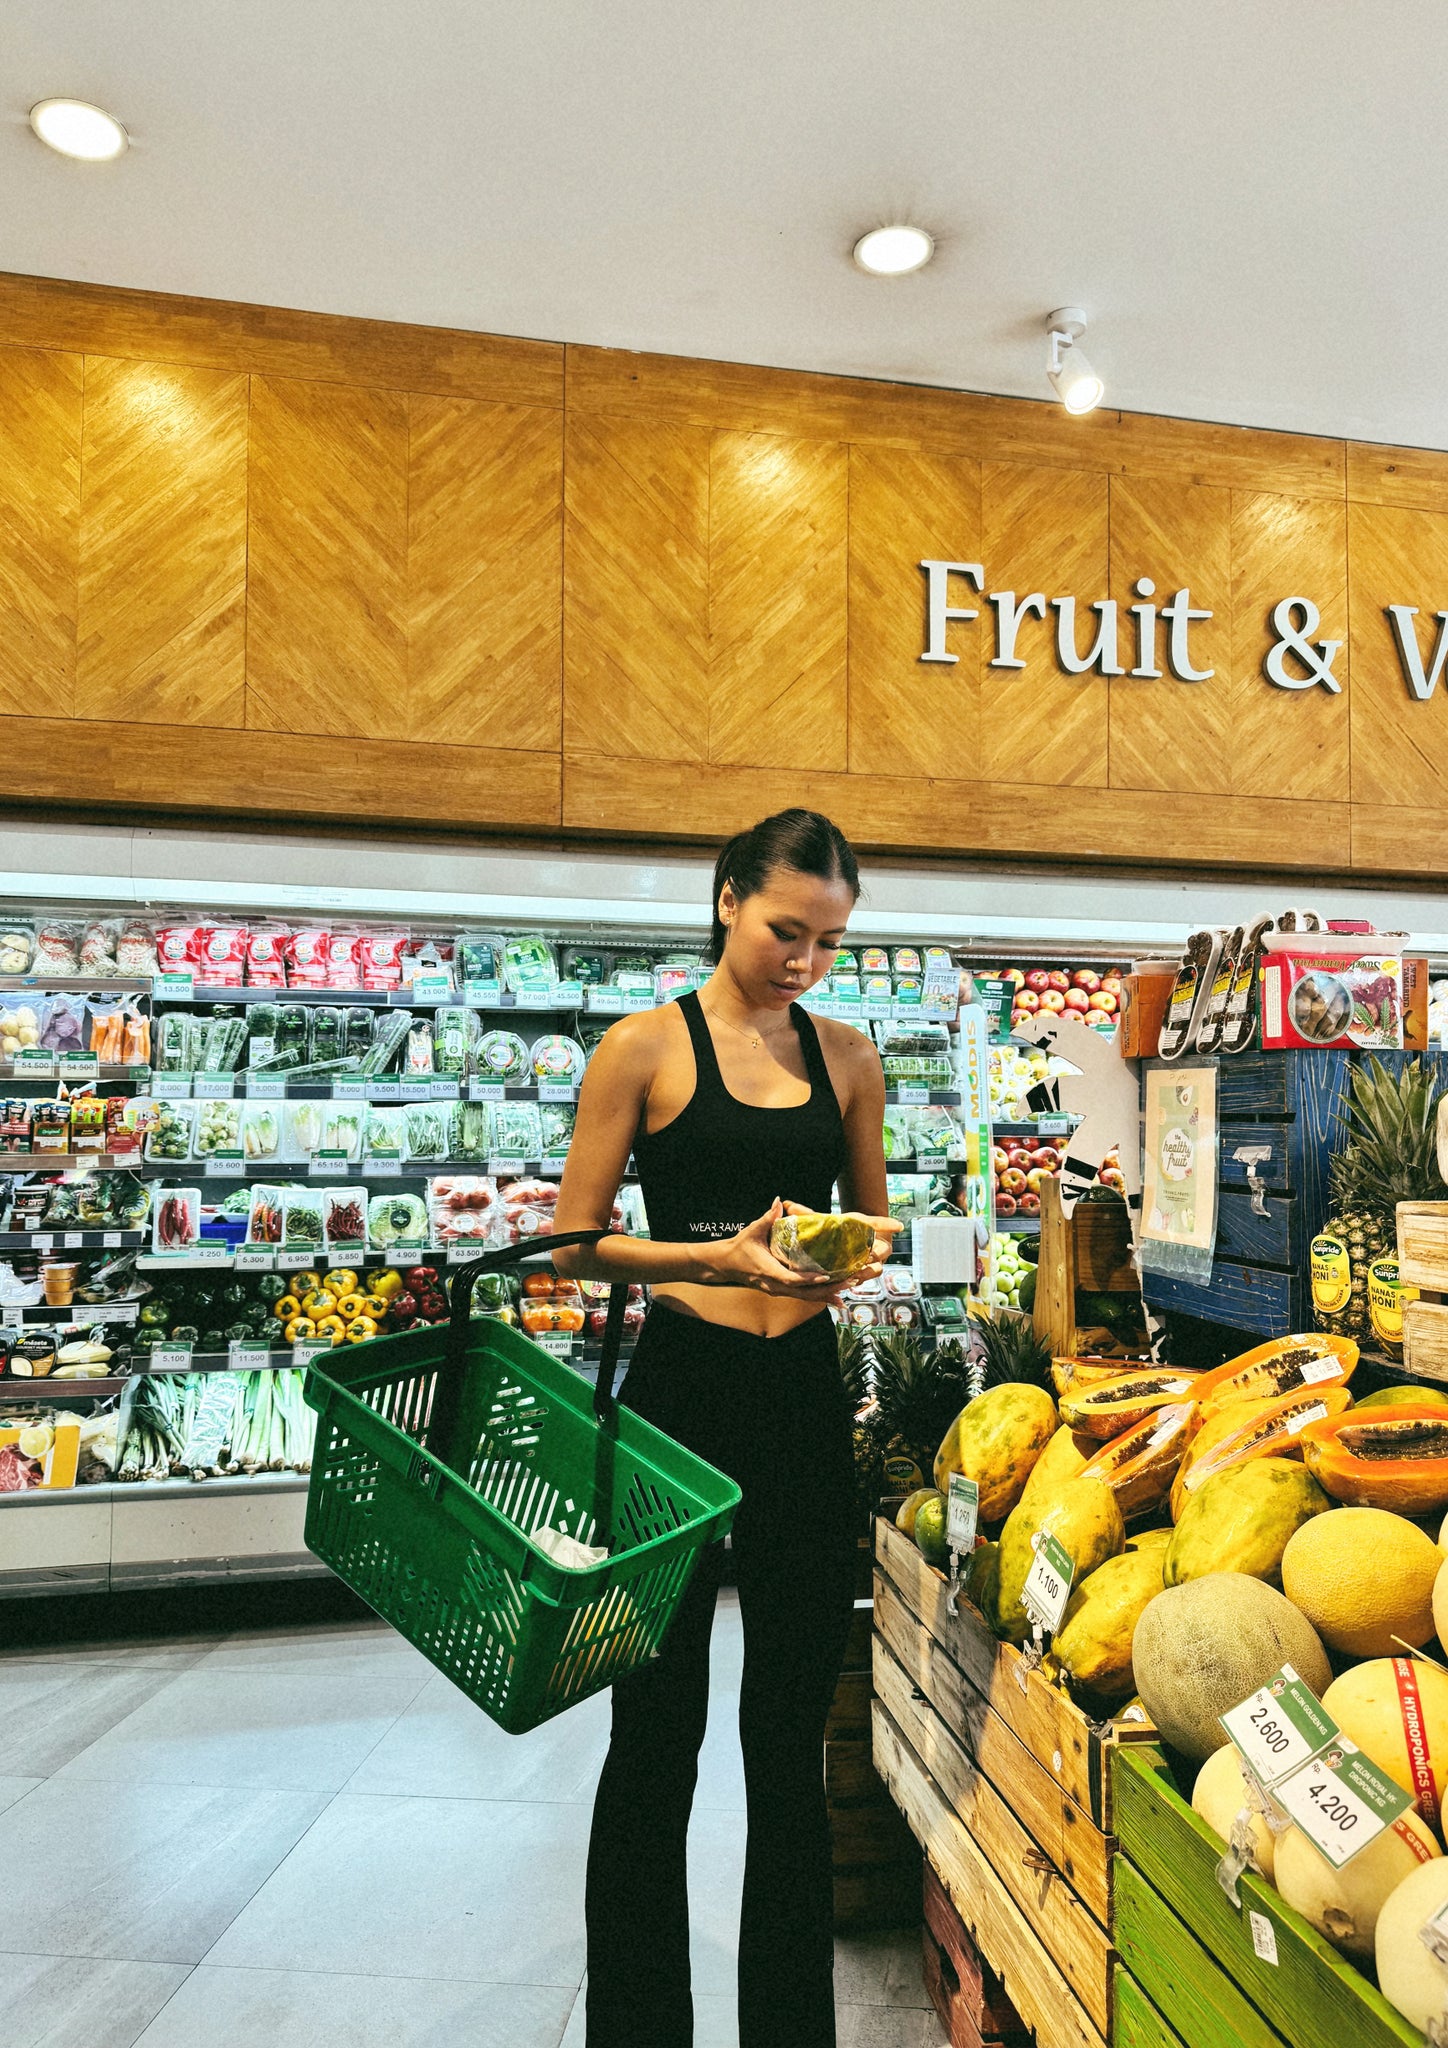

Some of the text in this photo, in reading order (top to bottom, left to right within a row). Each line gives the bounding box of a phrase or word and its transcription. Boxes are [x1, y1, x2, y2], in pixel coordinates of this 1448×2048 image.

[920, 558, 1215, 683] Fruit
[1261, 595, 1343, 694] &
[1409, 963, 1417, 988] SWEET
[966, 1020, 980, 1118] MODIS
[1163, 1139, 1193, 1158] healthy
[1166, 1152, 1188, 1171] fruit
[689, 1222, 717, 1232] WEAR
[1313, 1245, 1340, 1255] Sunpride
[1374, 1268, 1400, 1280] Sunpri
[1371, 1286, 1396, 1298] NANAS
[1371, 1294, 1396, 1309] HONI
[162, 1354, 185, 1362] 5.100
[239, 1354, 265, 1362] 11.500
[1038, 1567, 1059, 1599] 1.100
[1290, 1687, 1328, 1736] MELON GOLDEN KG
[1249, 1707, 1290, 1754] 2.600
[1403, 1696, 1430, 1788] HYDROPONICS
[1421, 1791, 1436, 1825] GREE
[1348, 1770, 1387, 1808] DROPONIC KG
[1351, 1760, 1373, 1781] MELON
[1368, 1776, 1389, 1796] ROYAL
[1308, 1784, 1358, 1831] 4.200
[1406, 1832, 1428, 1860] GRE
